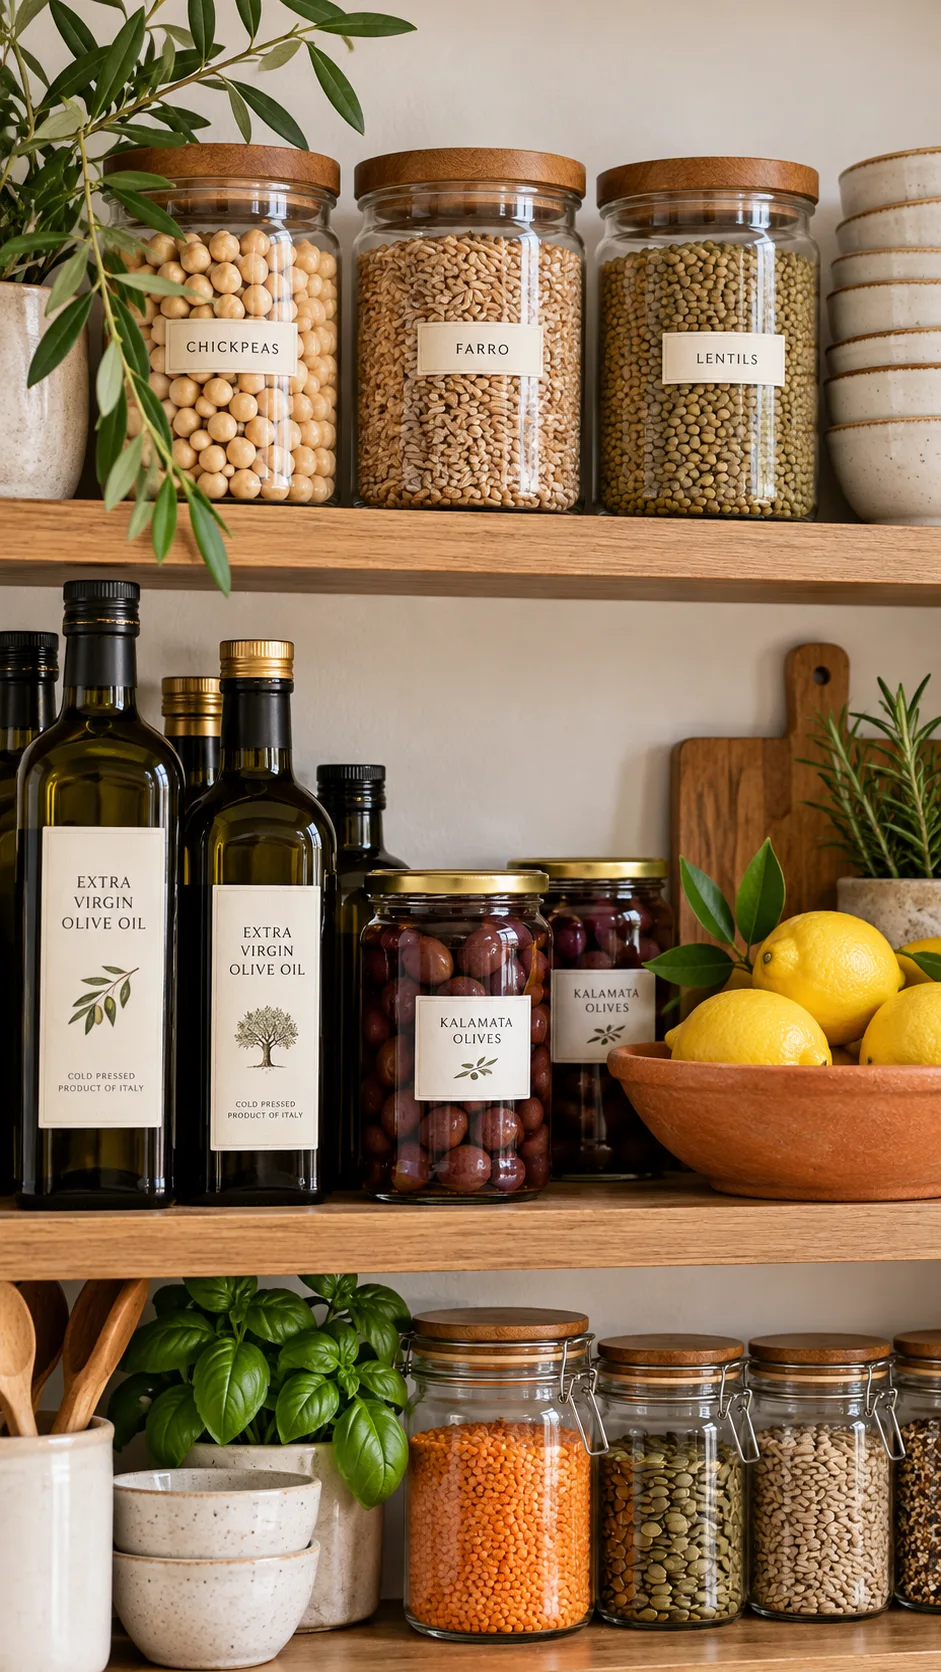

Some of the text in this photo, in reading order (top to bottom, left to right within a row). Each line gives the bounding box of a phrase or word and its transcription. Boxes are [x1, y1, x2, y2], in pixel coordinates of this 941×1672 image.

[186, 340, 280, 355] CHICKPEAS
[456, 343, 509, 355] FARRO
[696, 353, 758, 365] LENTILS
[76, 876, 131, 889] EXTRA
[74, 896, 134, 909] VIRGIN
[62, 916, 147, 930] OLIVE OIL
[243, 926, 292, 939] EXTRA
[240, 945, 294, 957] VIRGIN
[229, 964, 306, 976] OLIVE OIL
[574, 988, 640, 999] KALAMATA
[585, 1003, 630, 1013] OLIVES
[440, 1017, 513, 1029] KALAMATA
[453, 1033, 502, 1045] OLIVES
[67, 1072, 136, 1080] COLD PRESSED
[58, 1084, 145, 1092] PRODUCT OF ITALY
[235, 1100, 296, 1108] COLD PRESSED
[227, 1111, 304, 1119] PRODUCT OF ITALY
